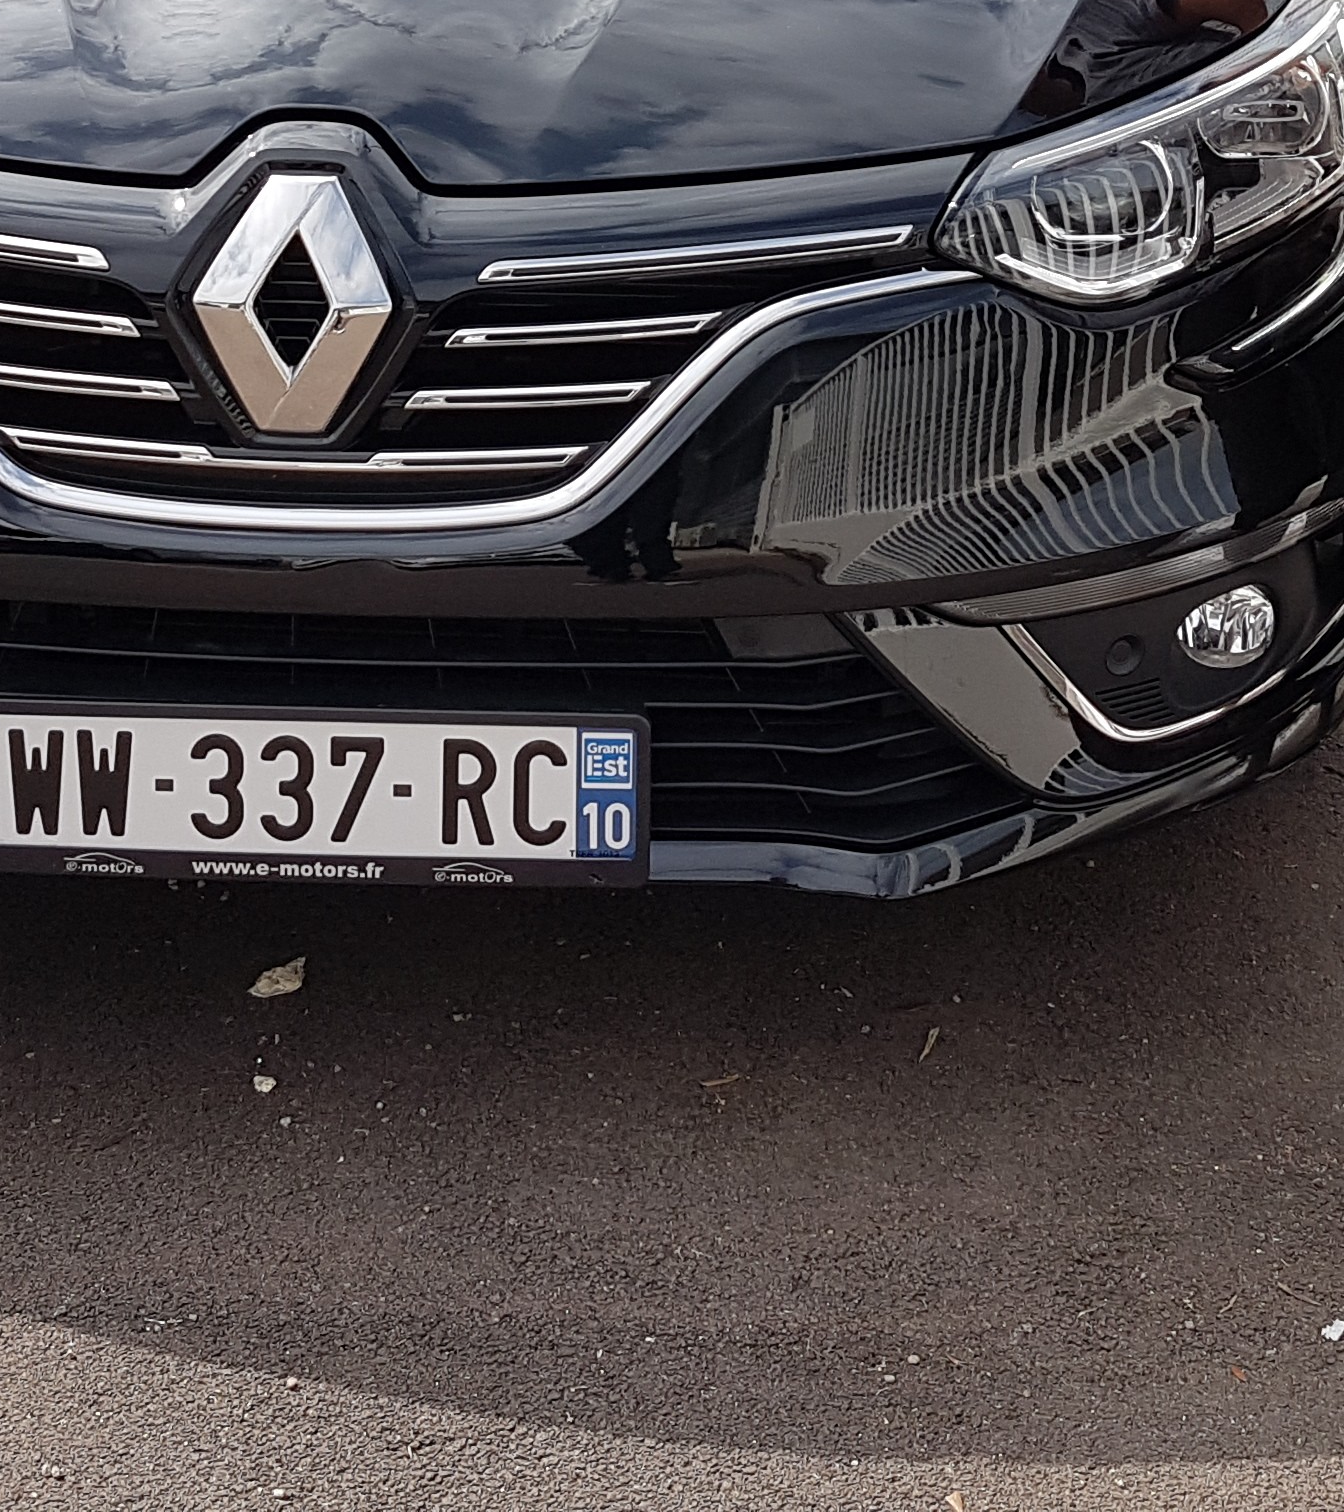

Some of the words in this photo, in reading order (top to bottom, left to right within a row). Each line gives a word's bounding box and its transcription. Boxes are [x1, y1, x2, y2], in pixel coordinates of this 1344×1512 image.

[587, 742, 629, 754] Grand
[586, 754, 628, 777] Est
[8, 728, 568, 846] WW-337-RC
[582, 802, 631, 850] 10
[192, 861, 384, 879] www.e-motors.fr
